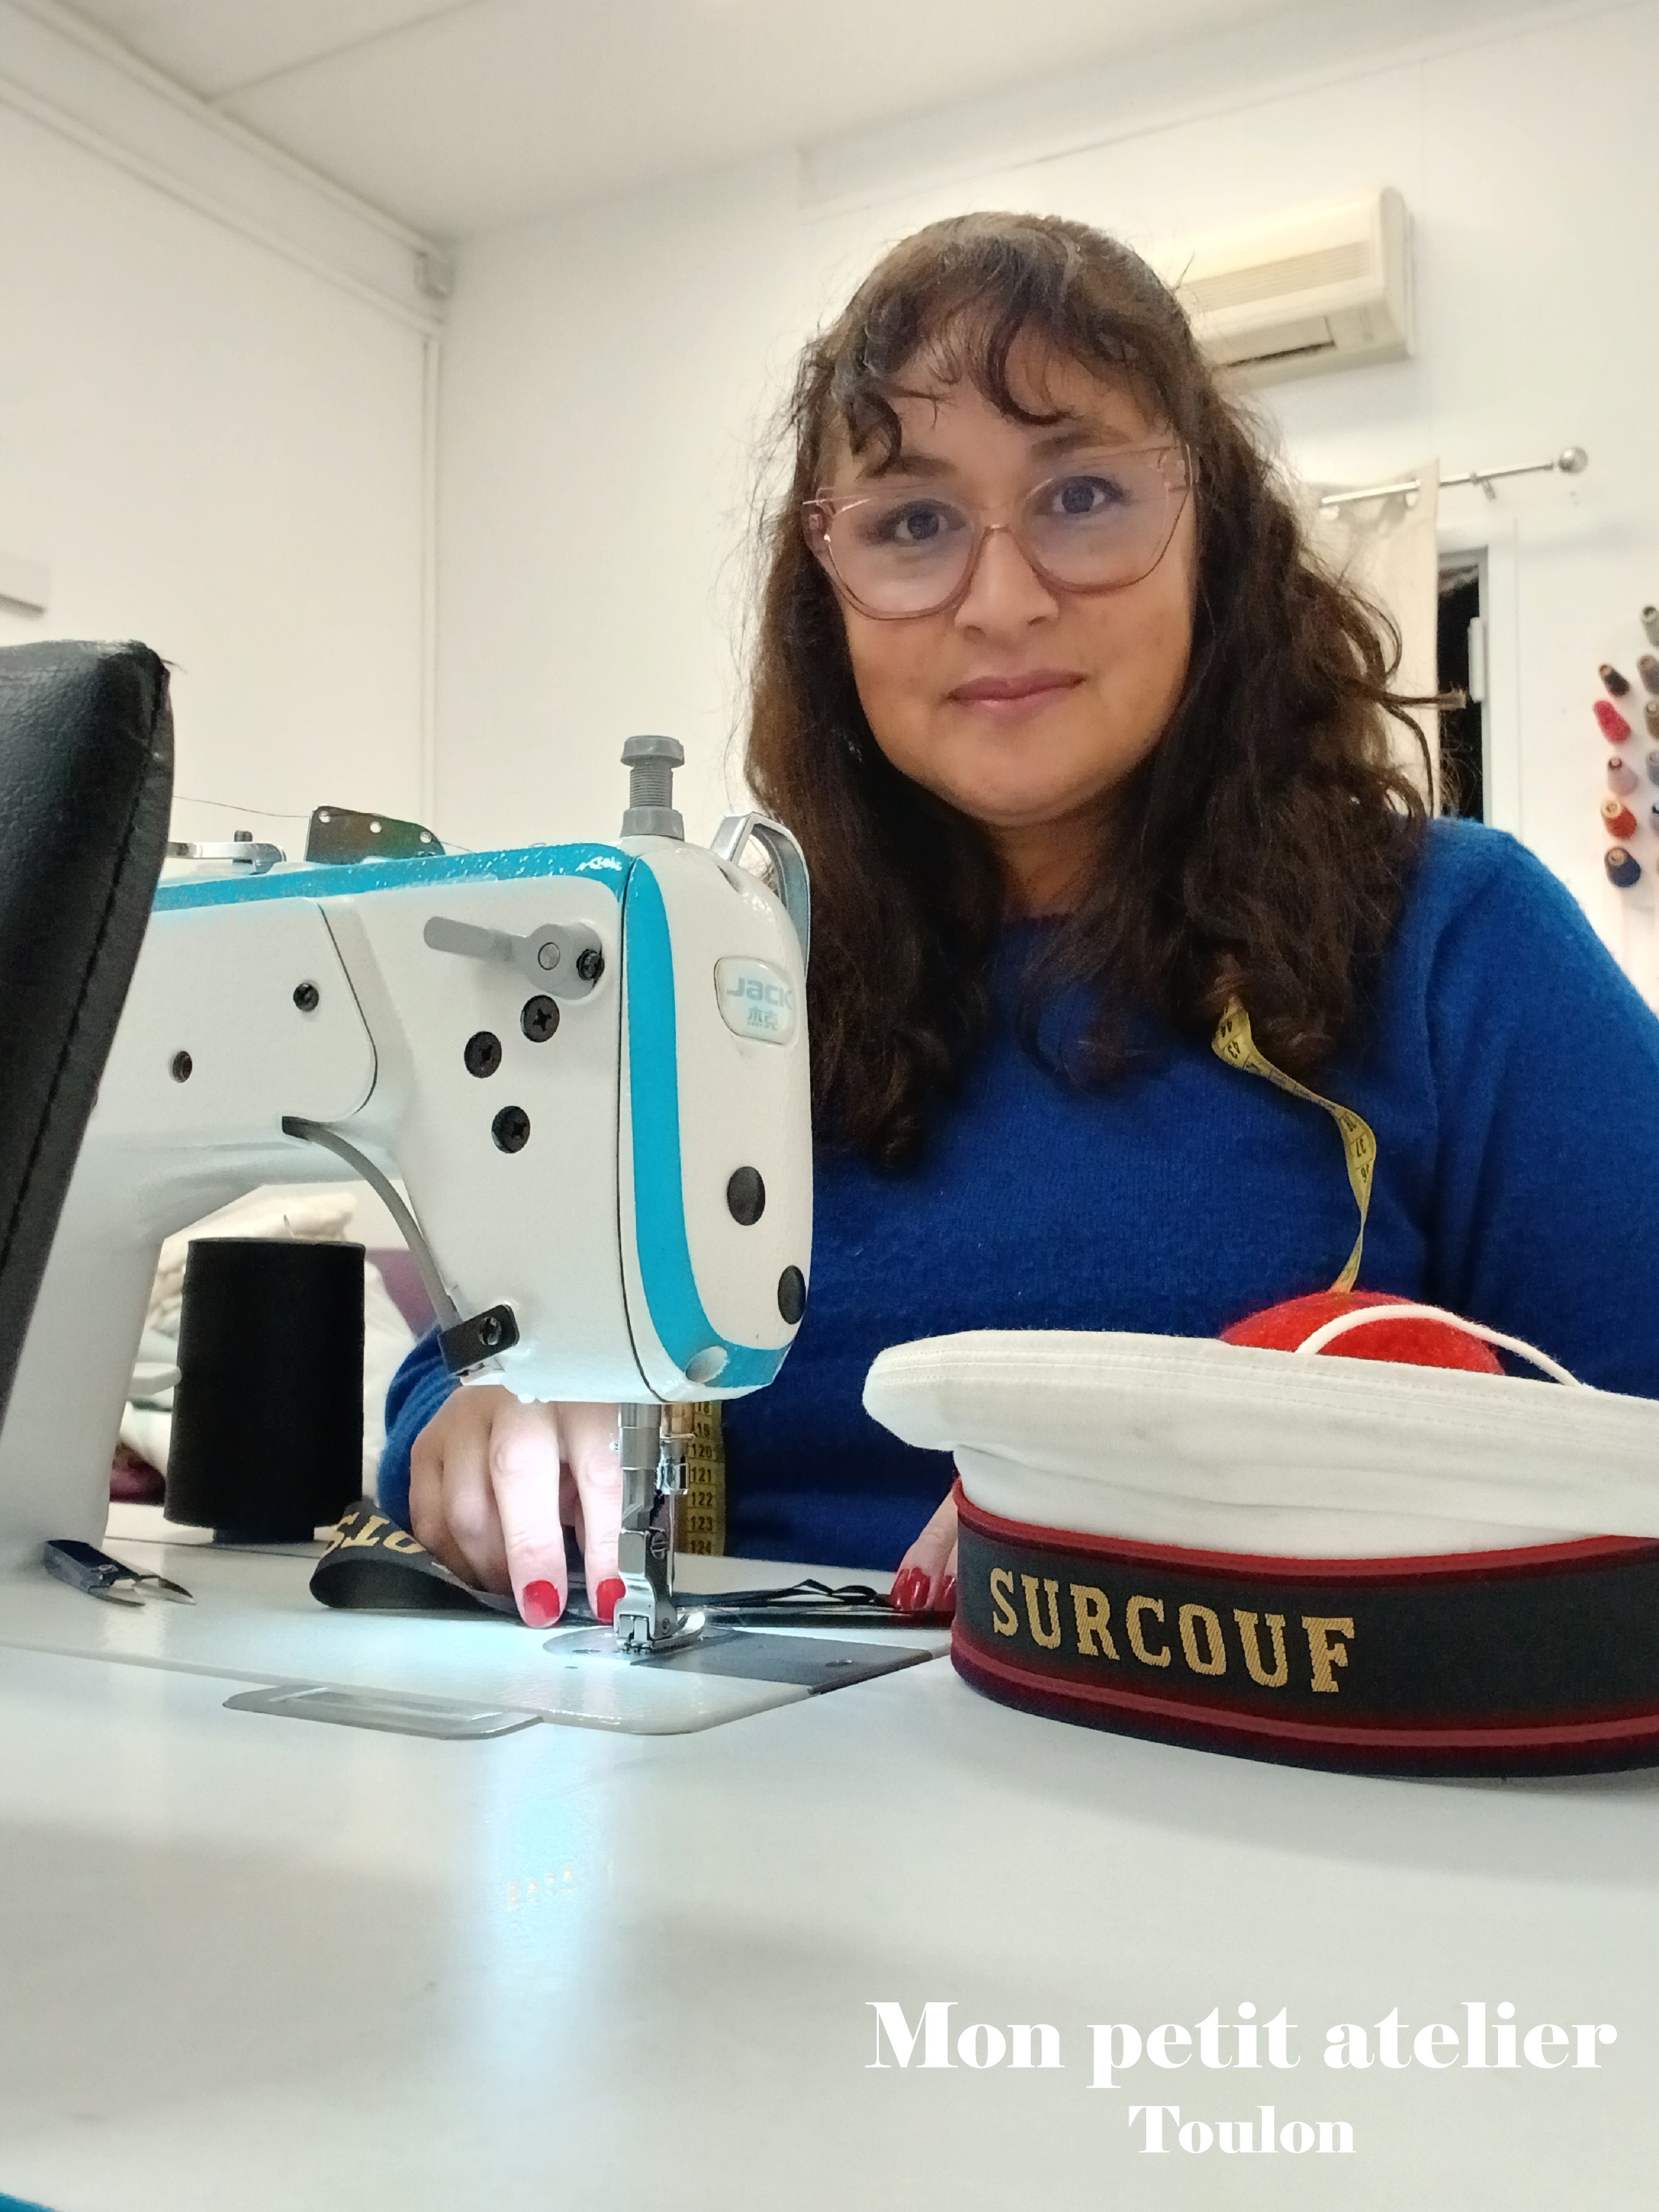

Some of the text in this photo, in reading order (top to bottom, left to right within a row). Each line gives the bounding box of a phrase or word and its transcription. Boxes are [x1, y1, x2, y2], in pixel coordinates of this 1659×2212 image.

[691, 1465, 712, 1483] 121
[691, 1492, 713, 1507] 122
[690, 1516, 713, 1531] 123
[689, 1539, 712, 1555] 124
[989, 1567, 1355, 1693] SURCOUF
